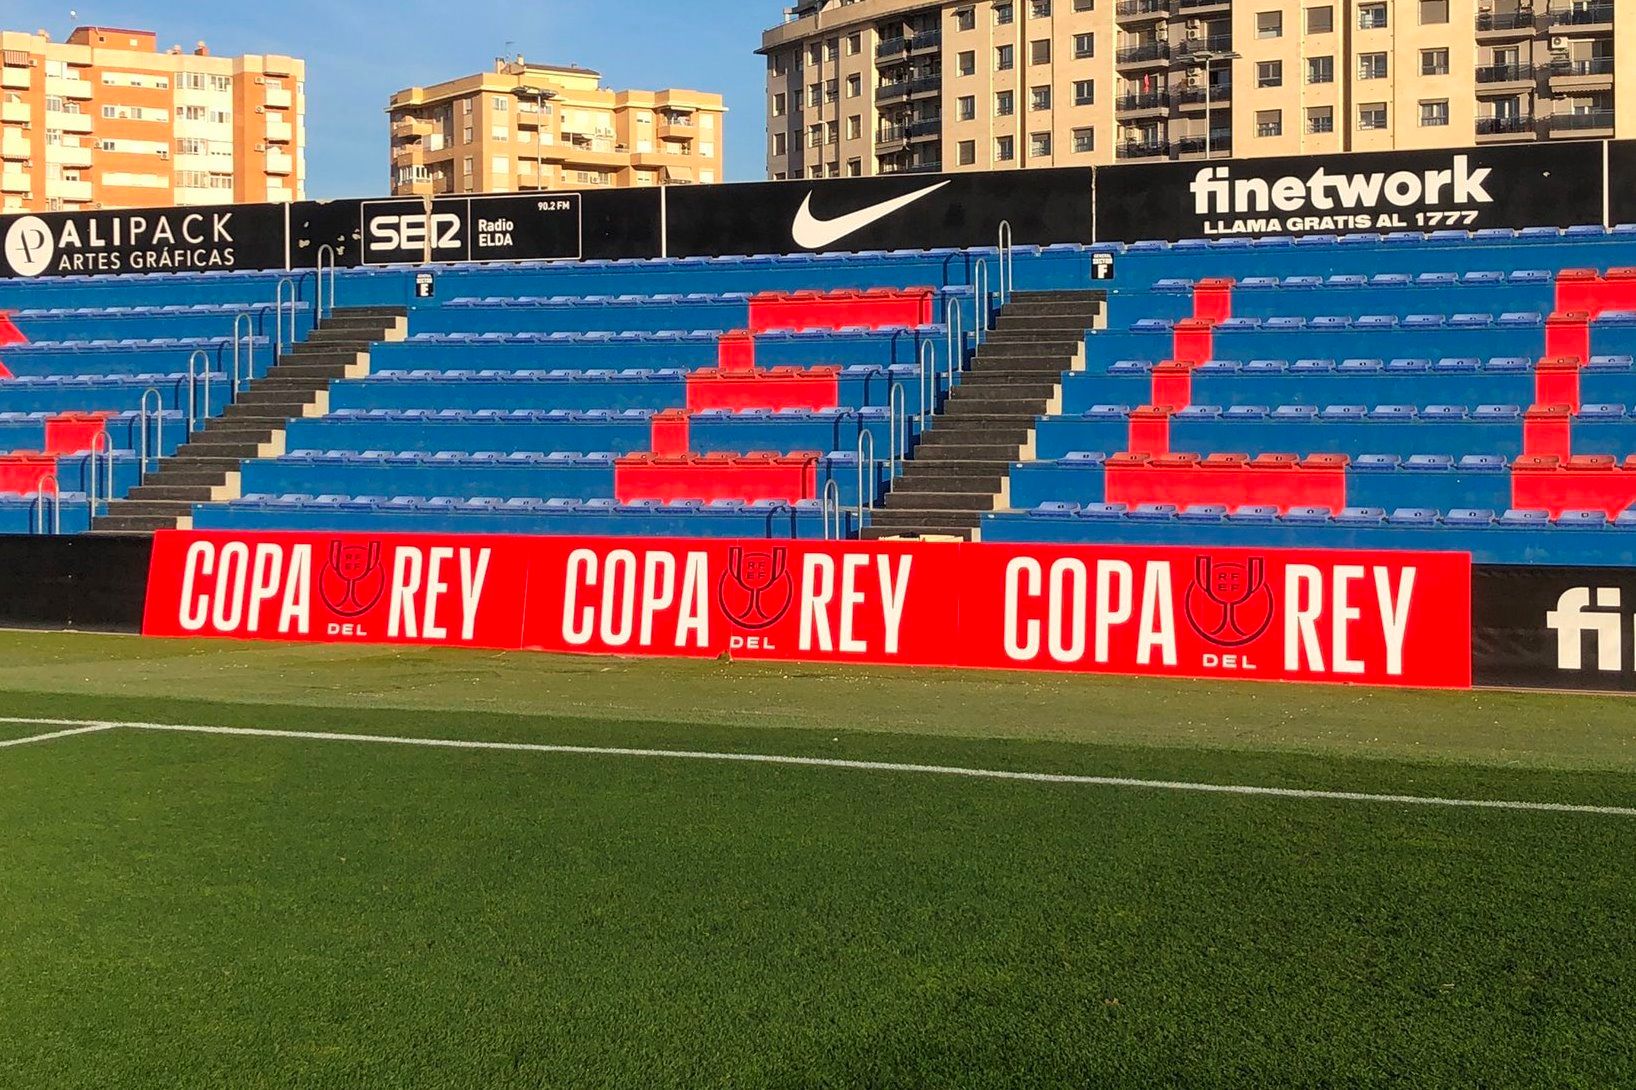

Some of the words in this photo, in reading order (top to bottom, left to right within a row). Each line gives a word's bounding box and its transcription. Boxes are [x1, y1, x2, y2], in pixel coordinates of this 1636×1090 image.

[1189, 154, 1494, 214] finetwork
[537, 201, 556, 211] 90.2
[556, 200, 570, 210] FM
[58, 212, 234, 248] ALIPACK
[370, 213, 462, 251] SER
[478, 218, 514, 232] Radio
[1203, 218, 1282, 235] LLAMA
[1286, 214, 1372, 232] GRATIS
[1375, 213, 1407, 228] AL
[1415, 210, 1479, 227] 1777
[478, 232, 513, 247] ELDA
[58, 252, 121, 271] ARTES
[129, 246, 235, 269] GRÁFICAS
[1097, 264, 1108, 279] F
[420, 283, 429, 297] E
[178, 540, 313, 634] COPA
[327, 623, 367, 636] DEL
[387, 546, 492, 641] REY
[561, 548, 710, 648] COPA
[729, 635, 776, 650] DEL
[798, 552, 914, 654] REY
[1003, 556, 1178, 666] COPA
[1202, 653, 1257, 669] DEL
[1284, 563, 1417, 676] REY
[1546, 586, 1636, 672] fi
